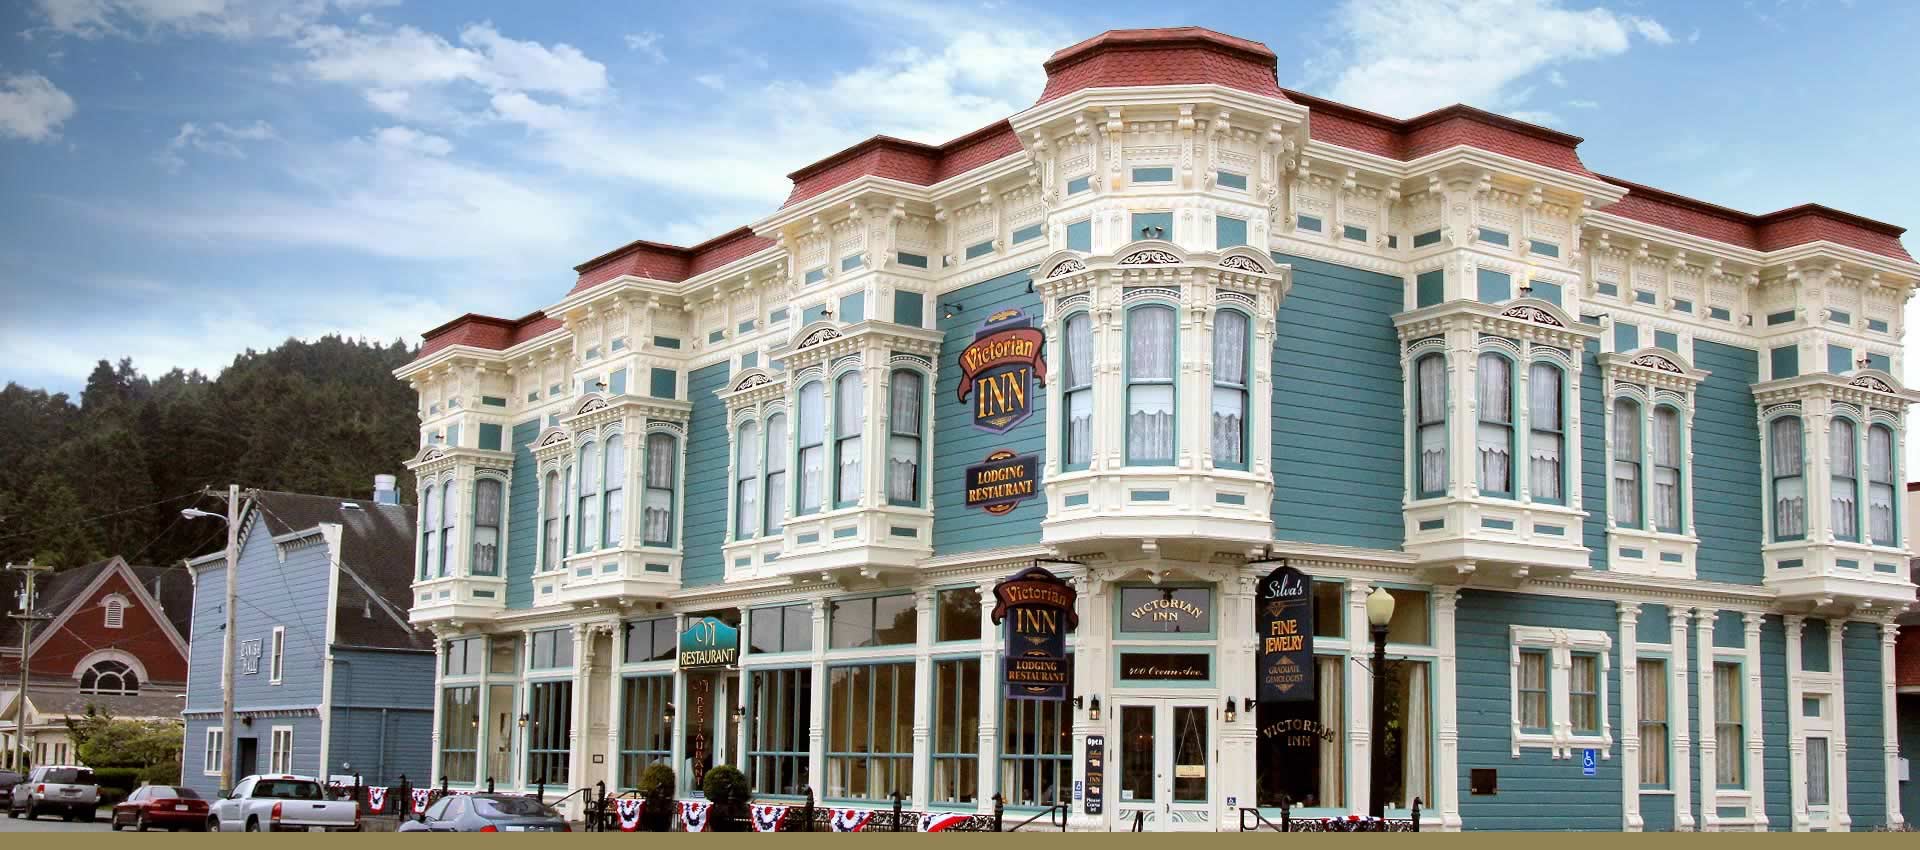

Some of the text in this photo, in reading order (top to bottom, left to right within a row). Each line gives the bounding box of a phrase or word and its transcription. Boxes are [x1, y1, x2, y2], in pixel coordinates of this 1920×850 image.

[965, 335, 1033, 371] Victorian
[978, 369, 1027, 418] INN
[978, 465, 1024, 484] LODGING
[969, 480, 1033, 502] RESTAURANT
[1006, 584, 1067, 606] Victorian
[1265, 574, 1304, 599] Silva's
[1130, 599, 1203, 620] VICTORIAN
[1152, 612, 1179, 622] INN
[1016, 607, 1057, 635] INN
[1272, 620, 1297, 635] FINE
[1266, 635, 1304, 655] JEWELRY
[681, 648, 735, 665] RESTAURANT
[1016, 660, 1057, 671] LODGING
[1008, 671, 1065, 681] RESTAURANT
[1129, 666, 1147, 676] 400
[1148, 665, 1178, 676] Ocean
[1263, 719, 1335, 742] VICTORIAN
[695, 696, 705, 786] RESTAURANT
[1087, 738, 1103, 746] Open
[1287, 735, 1310, 747] INN
